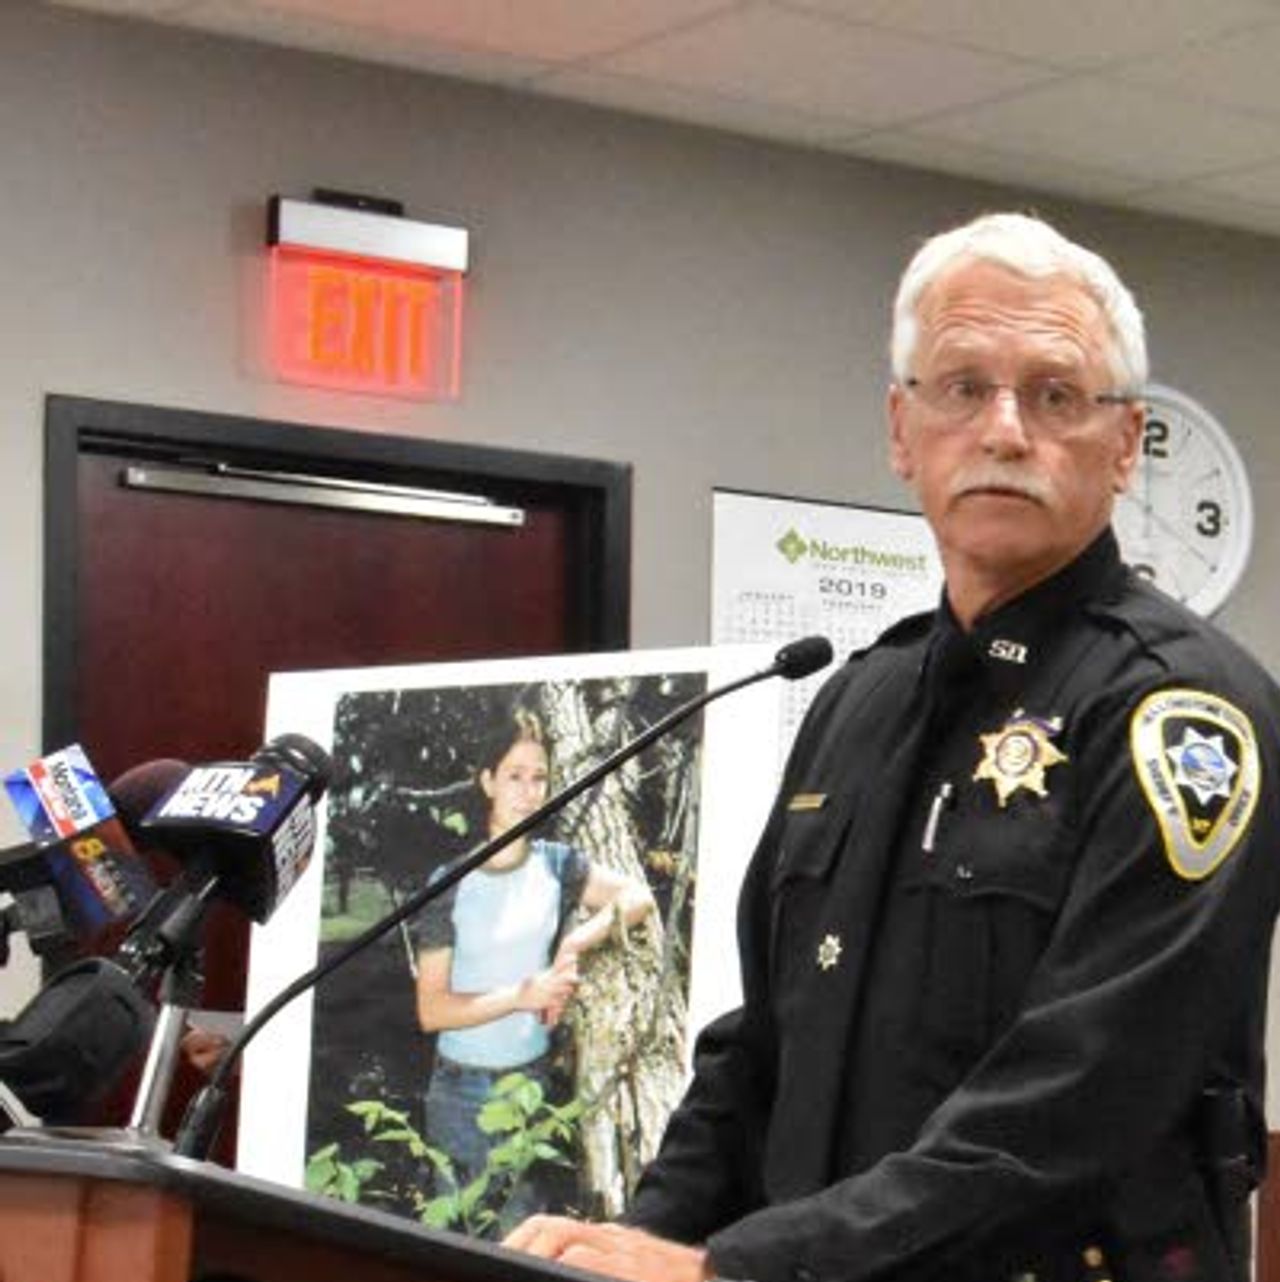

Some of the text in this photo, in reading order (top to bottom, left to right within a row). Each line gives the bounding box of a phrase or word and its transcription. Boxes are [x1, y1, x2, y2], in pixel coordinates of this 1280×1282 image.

[308, 264, 433, 386] EXIT
[1143, 420, 1169, 459] 2
[1196, 501, 1221, 537] 3
[809, 540, 927, 571] Northwest
[818, 576, 888, 600] 2019
[158, 791, 265, 824] NEWS
